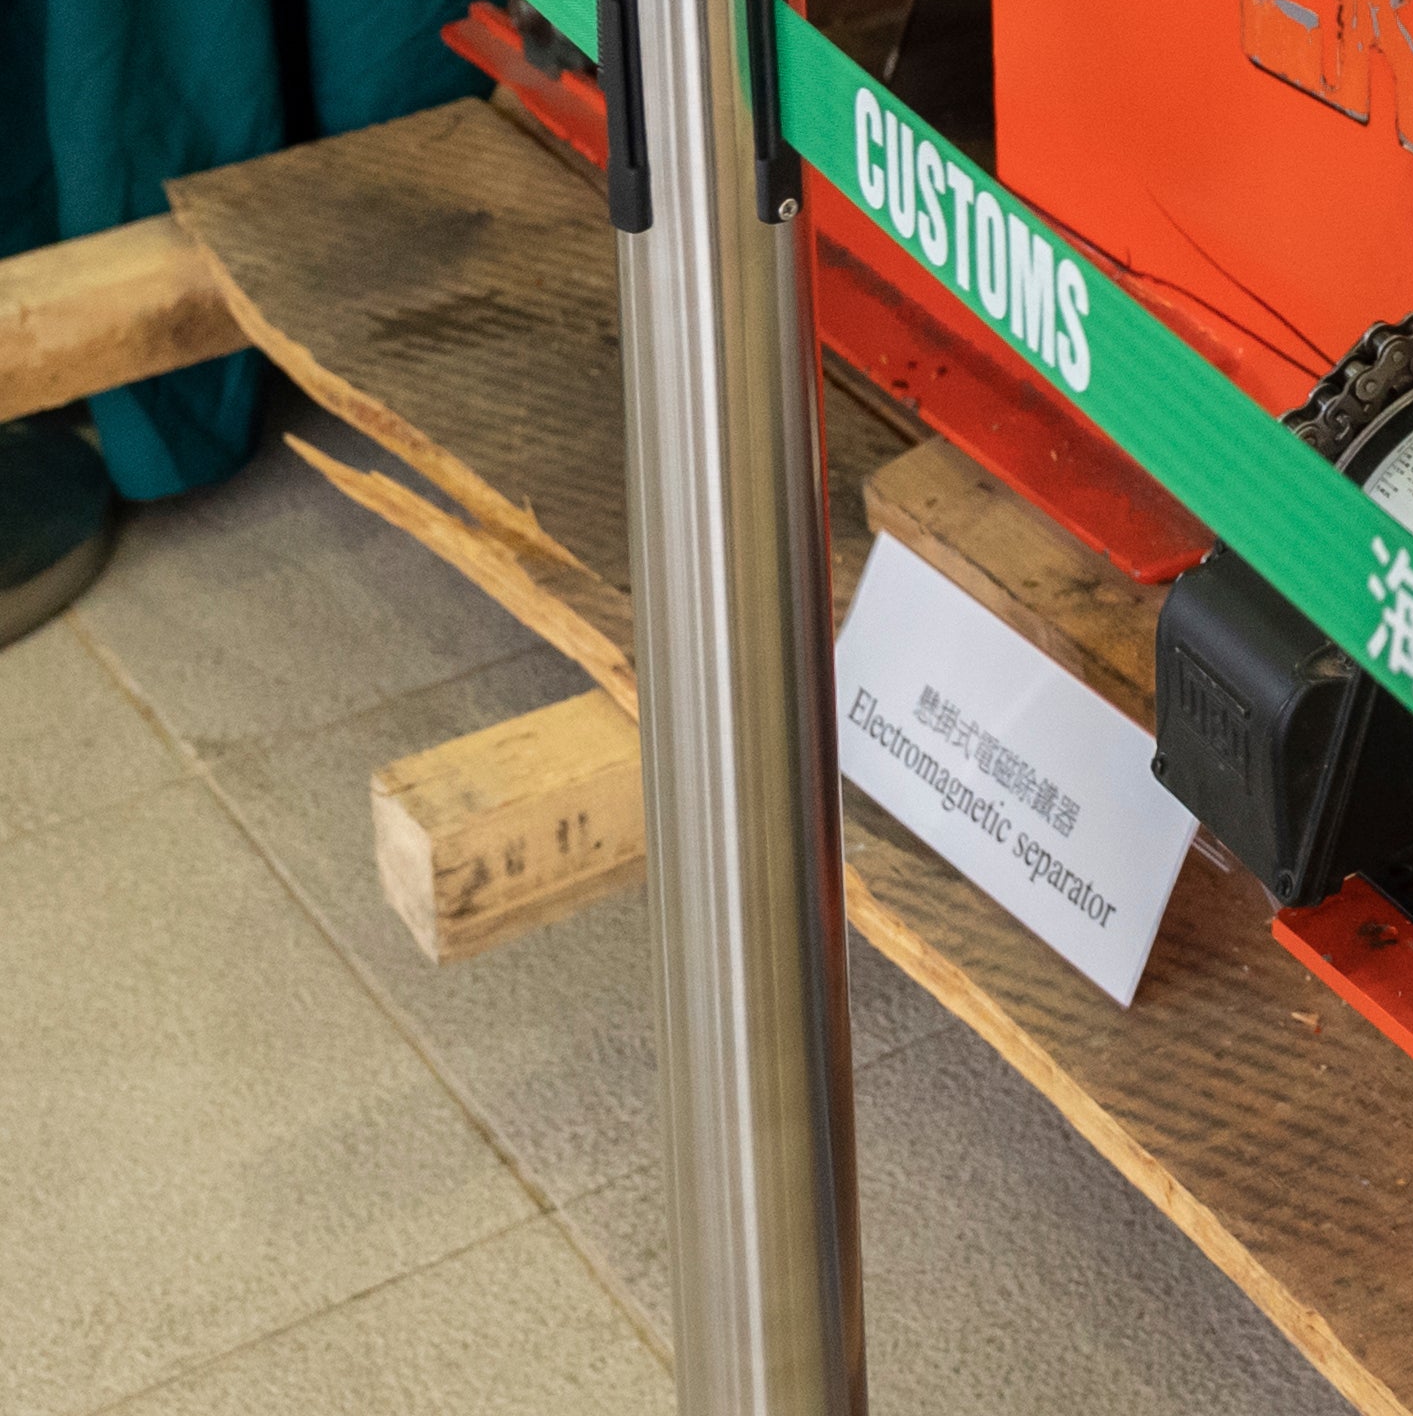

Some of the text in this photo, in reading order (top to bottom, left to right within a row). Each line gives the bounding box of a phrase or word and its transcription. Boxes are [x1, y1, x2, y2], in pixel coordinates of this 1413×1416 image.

[854, 87, 1091, 394] CUSTOMS
[847, 687, 1117, 929] Electromagnetic separator
